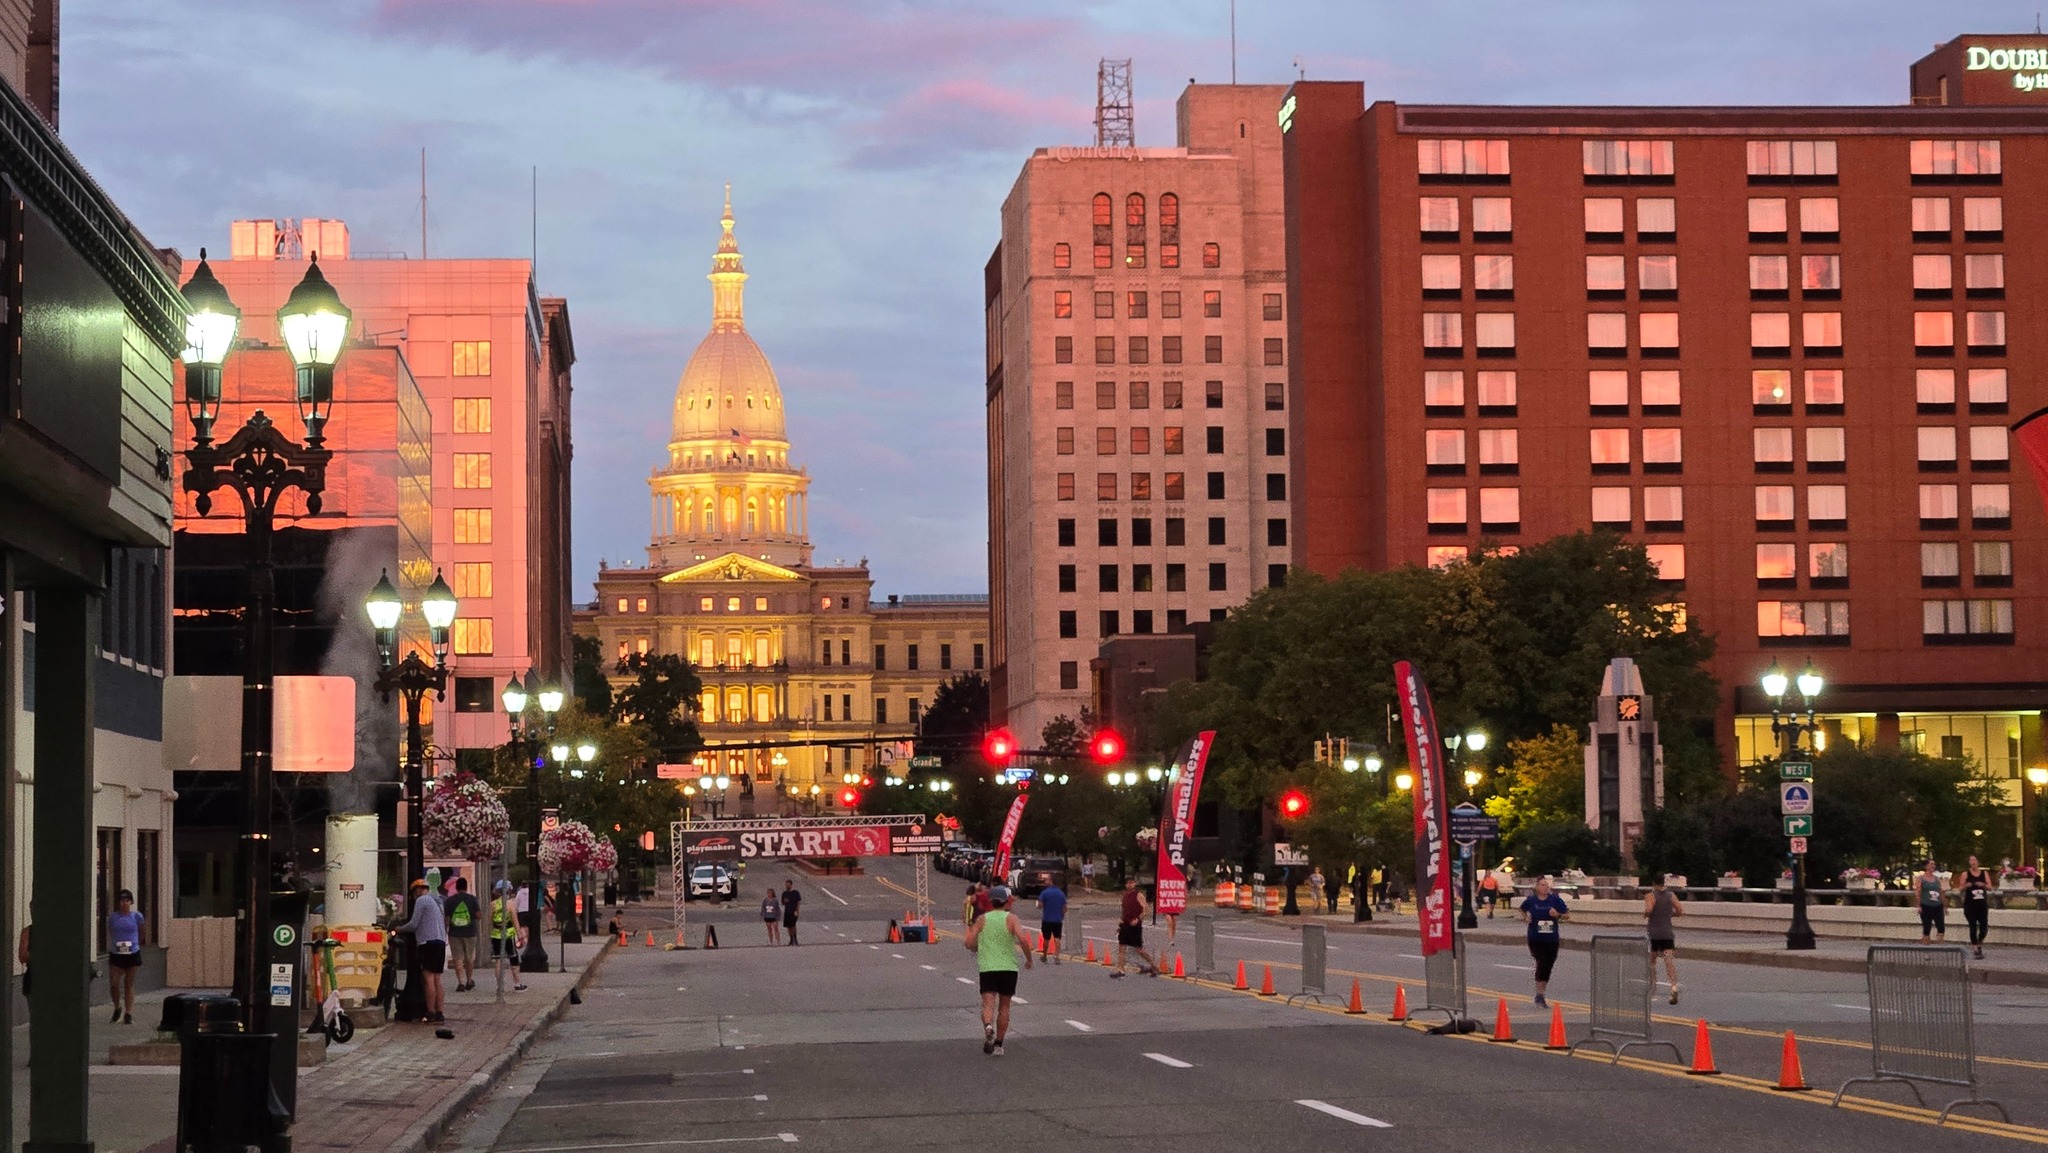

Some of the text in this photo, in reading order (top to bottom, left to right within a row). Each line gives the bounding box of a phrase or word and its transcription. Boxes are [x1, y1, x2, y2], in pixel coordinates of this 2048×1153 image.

[2014, 73, 2035, 92] by
[1785, 766, 1808, 776] WEST
[1168, 739, 1205, 866] playmakers
[1001, 796, 1024, 847] START
[740, 830, 845, 857] START
[908, 835, 941, 843] MARATHON
[686, 843, 736, 854] playmakers
[1159, 879, 1186, 889] RUN
[343, 890, 360, 900] HOT
[1159, 890, 1186, 898] WALK
[1159, 898, 1186, 907] LIVE
[280, 929, 291, 942] P
